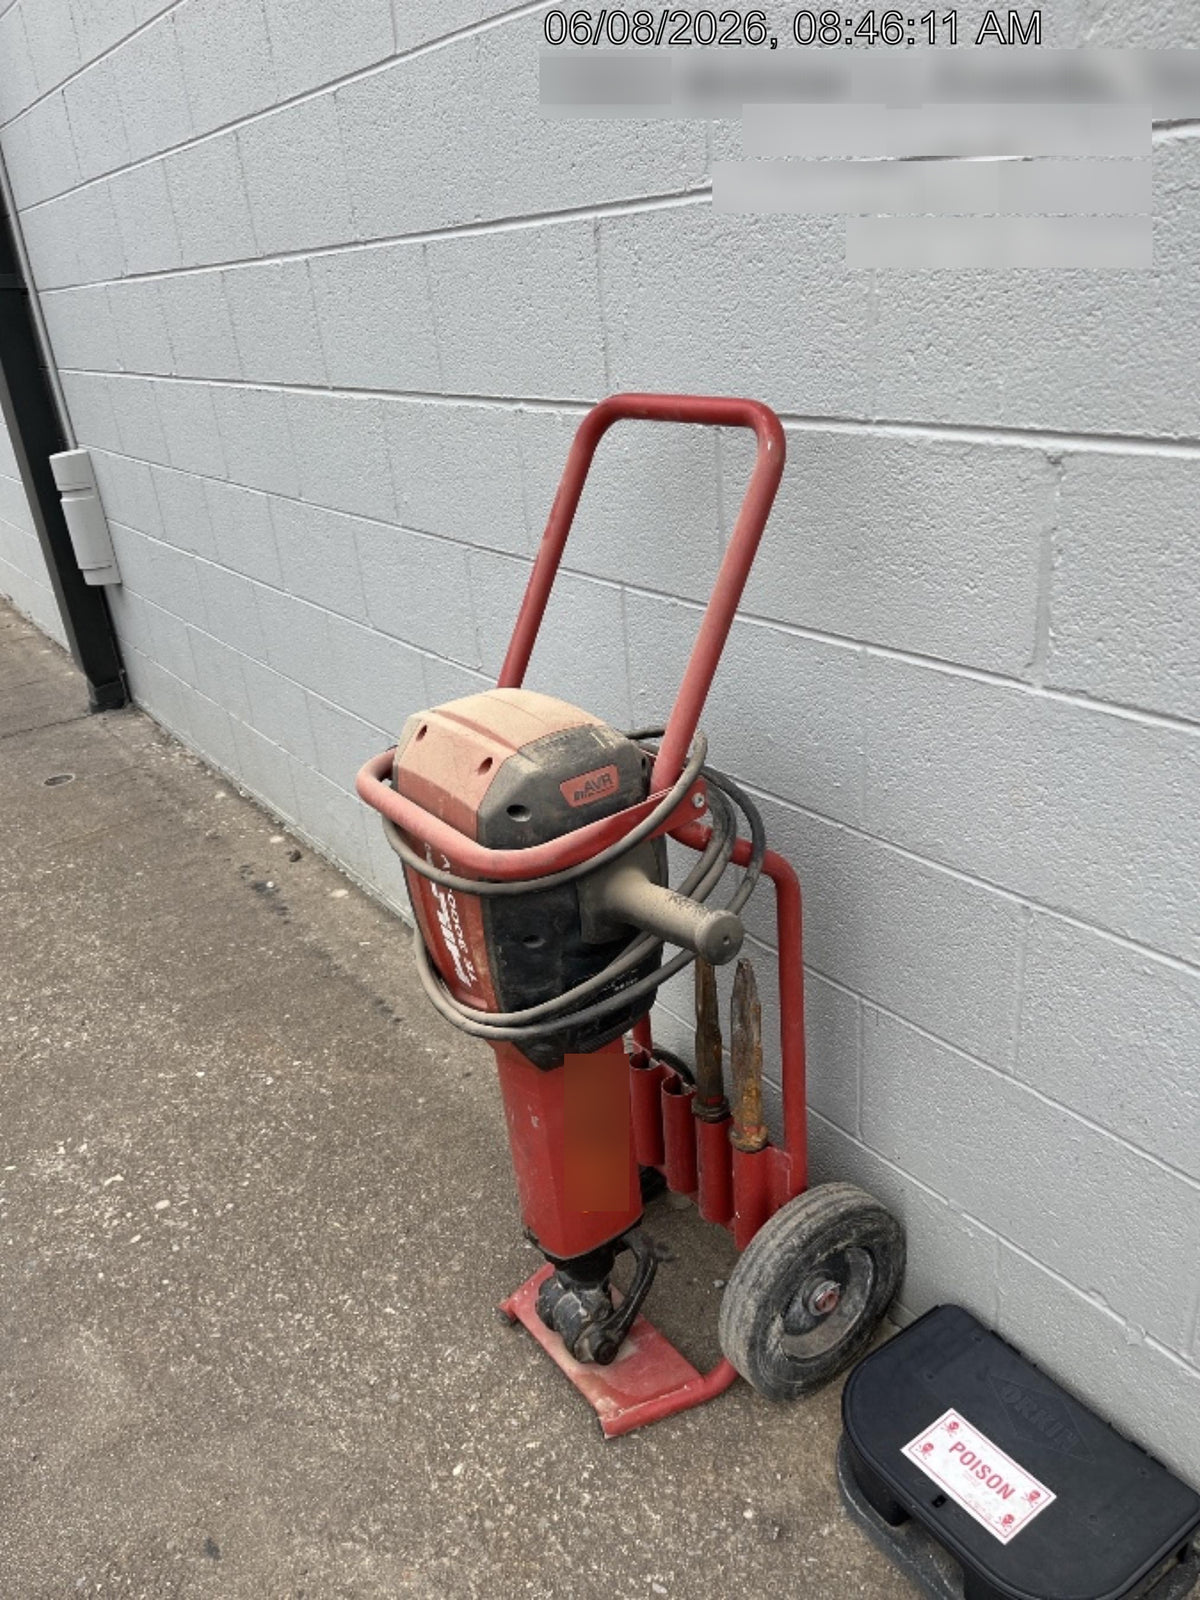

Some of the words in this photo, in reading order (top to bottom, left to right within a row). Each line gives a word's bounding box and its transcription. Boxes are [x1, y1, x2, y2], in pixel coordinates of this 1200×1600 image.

[585, 773, 614, 793] AVR
[1002, 1386, 1081, 1457] ORKIN
[948, 1441, 1016, 1500] POISON
